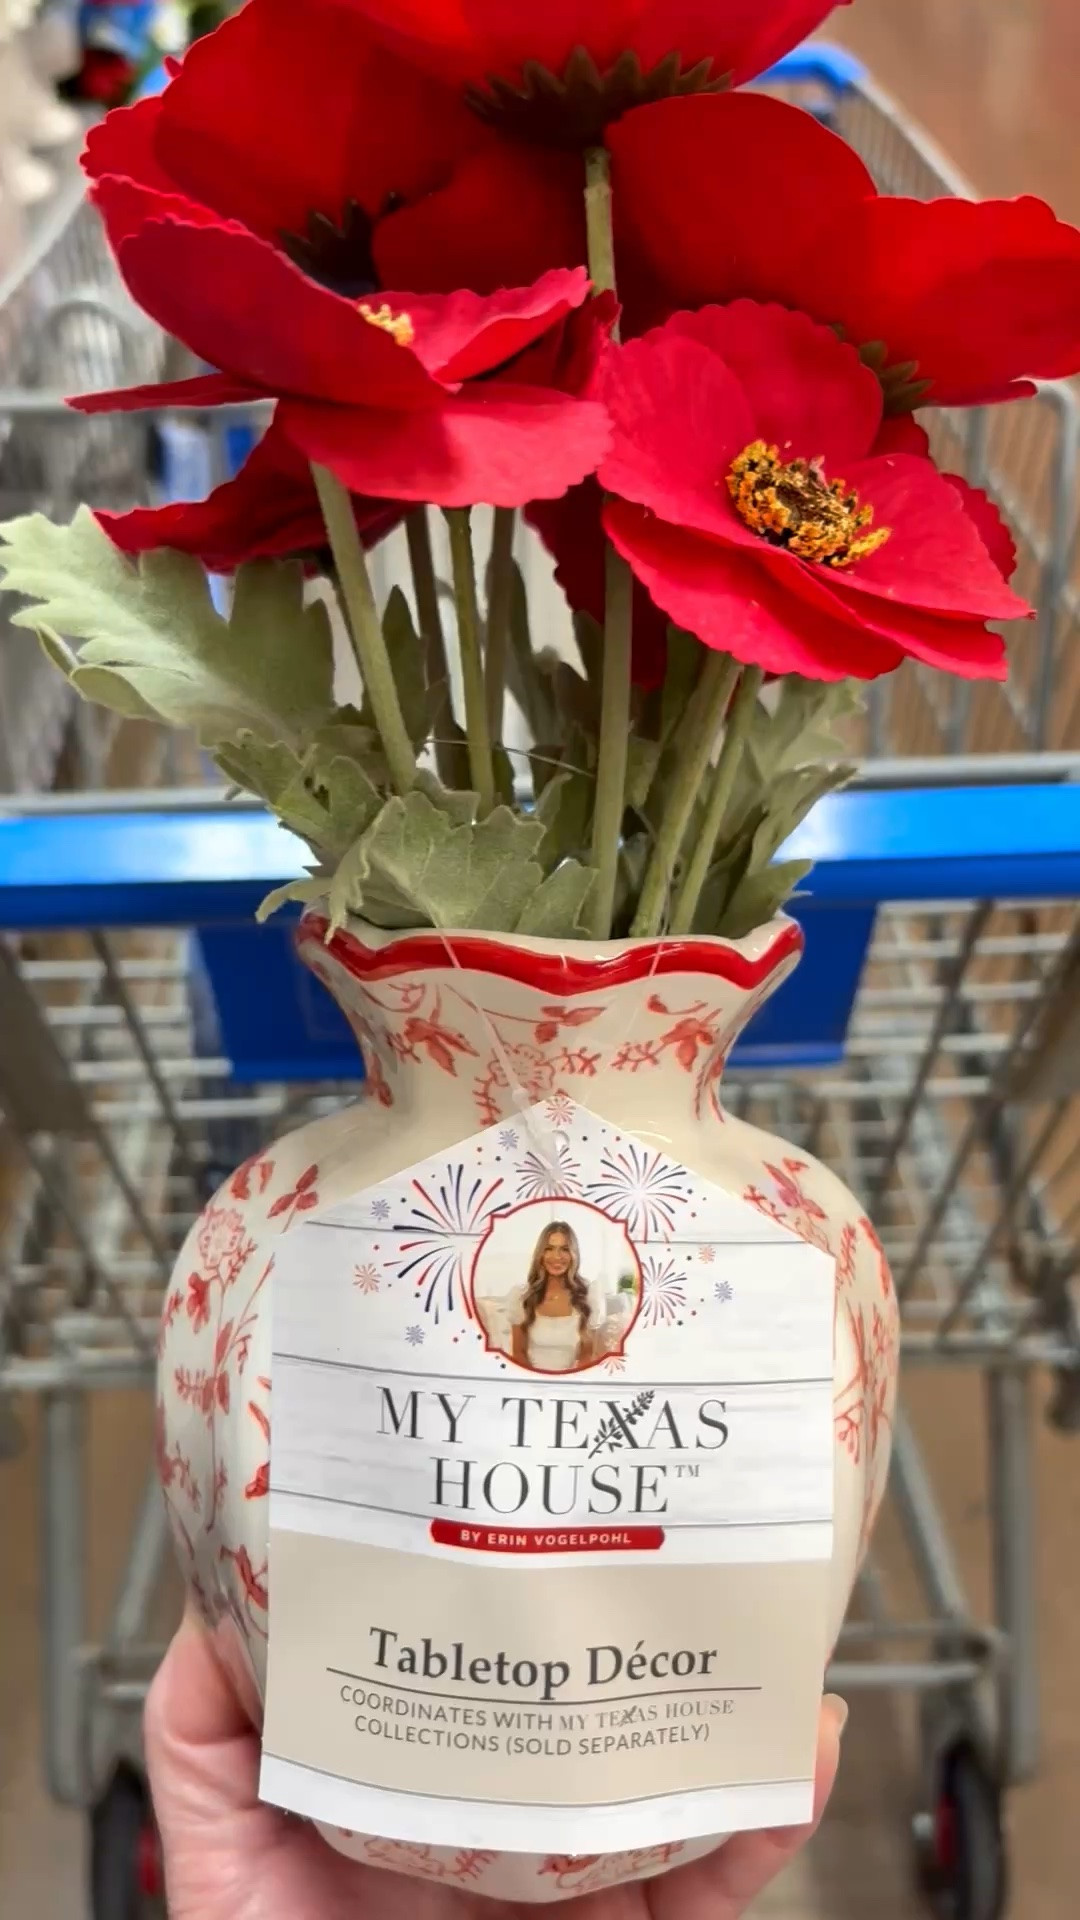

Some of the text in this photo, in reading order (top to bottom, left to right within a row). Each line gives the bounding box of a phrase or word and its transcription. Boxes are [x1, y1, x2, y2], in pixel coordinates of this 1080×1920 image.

[375, 1386, 730, 1456] MY TEXAS
[460, 1529, 632, 1547] BY ERIN VOGELPOHL
[369, 1626, 718, 1701] Tabletop Décor
[339, 1684, 735, 1732] COORDINATES WITH MY TEXAS HOUSE
[354, 1714, 711, 1756] COLLECTIONS (SOLD SEPARATELY)
